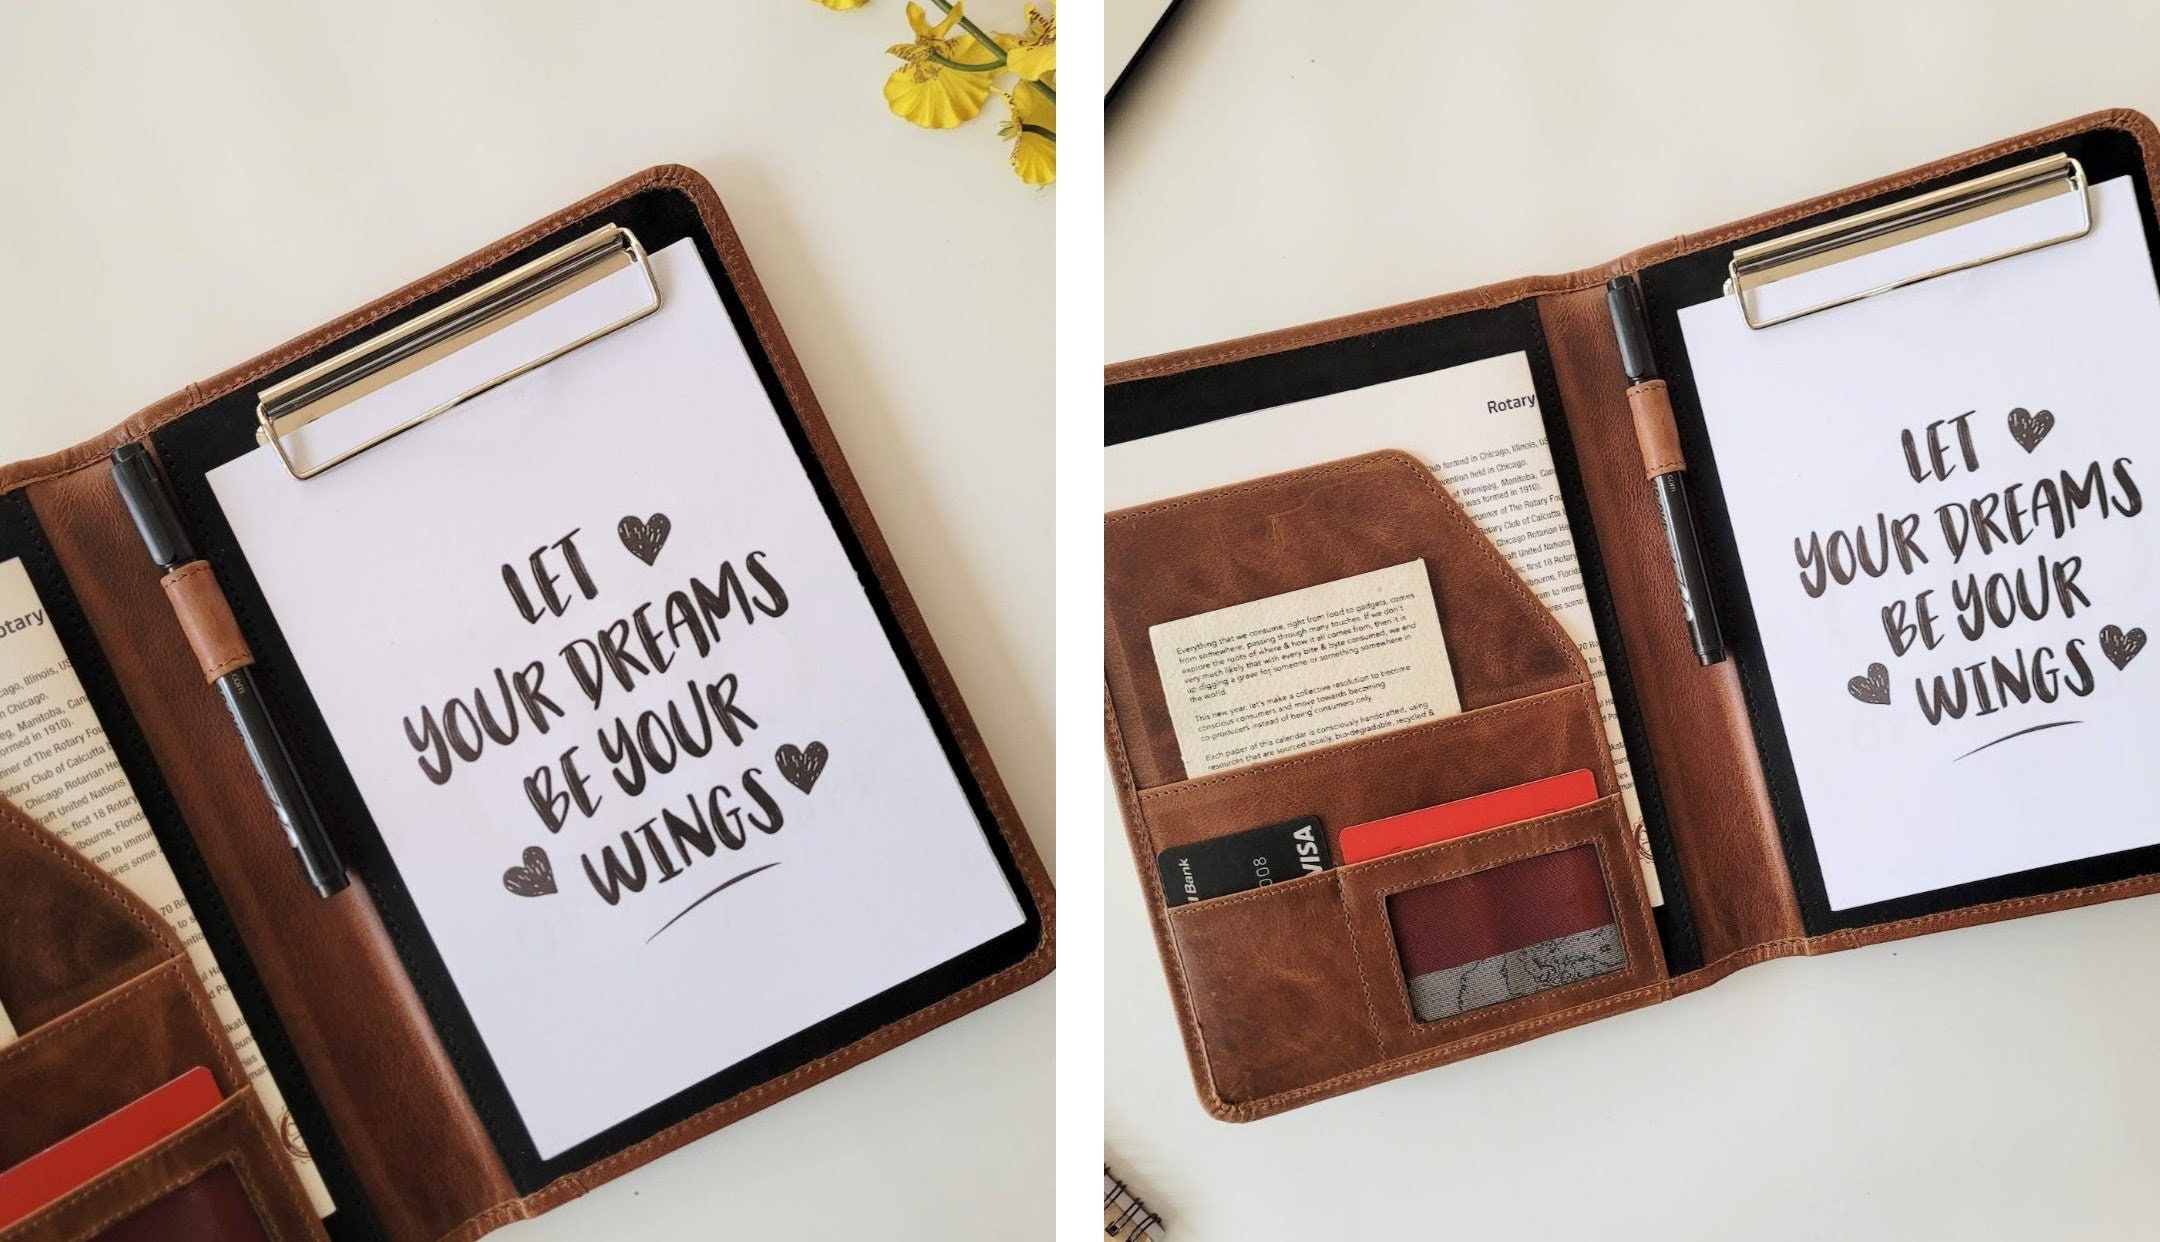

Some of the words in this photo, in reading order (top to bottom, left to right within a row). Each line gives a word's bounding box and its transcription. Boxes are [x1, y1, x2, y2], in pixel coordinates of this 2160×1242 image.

[1487, 394, 1536, 414] Rotary
[1901, 410, 1980, 484] LET
[1524, 496, 1548, 511] Rotary
[1794, 512, 1929, 599] YOUR
[1934, 457, 2143, 564] DREAMS
[501, 527, 599, 625] LET
[1881, 589, 1945, 658] BE
[1951, 555, 2092, 642] YOUR
[403, 661, 565, 785] YOUR
[558, 550, 789, 711] DREAMS
[1915, 638, 2095, 726] WINGS
[31, 769, 54, 785] Club
[67, 746, 106, 769] Calcutta
[34, 749, 53, 765] The
[53, 733, 85, 755] Rotary
[523, 745, 602, 835] BE
[598, 673, 758, 797] YOUR
[24, 788, 64, 810] Chicago
[64, 768, 105, 791] Rotarian
[58, 795, 89, 817] United
[89, 778, 126, 801] Nations
[71, 815, 92, 831] first
[107, 794, 138, 815] Rotary
[131, 850, 158, 868] some
[580, 768, 784, 906] WINGS
[1293, 824, 1323, 876] VISA
[1178, 857, 1197, 894] Bank
